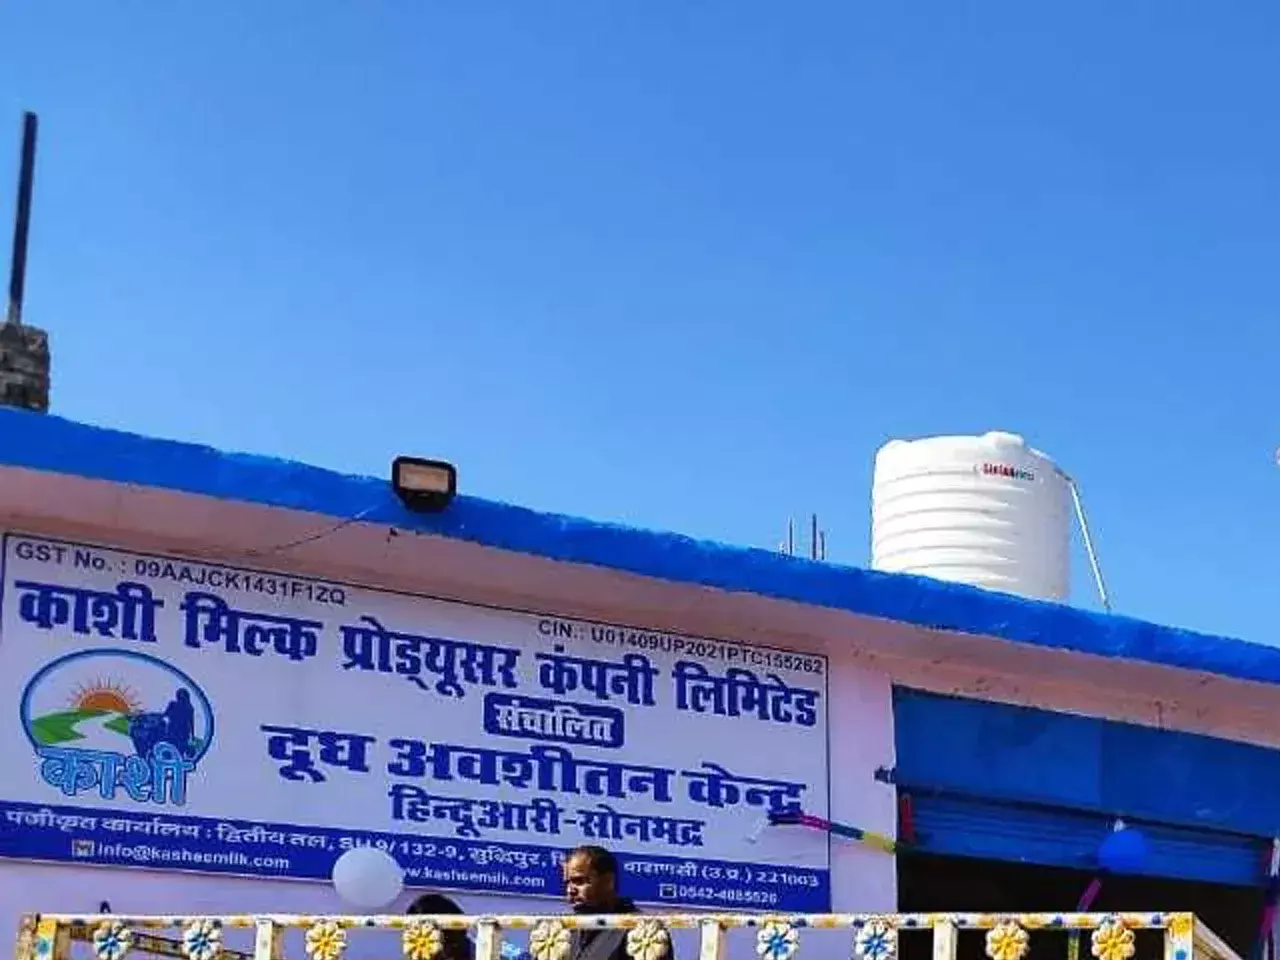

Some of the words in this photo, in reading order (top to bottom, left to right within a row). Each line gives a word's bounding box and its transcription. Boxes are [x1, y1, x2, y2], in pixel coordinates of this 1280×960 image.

[15, 541, 67, 564] GST
[75, 551, 113, 572] No.
[135, 559, 346, 606] 09AAJCK1431F1ZQ
[14, 580, 164, 643] काशी
[179, 591, 323, 661] मिल्क
[339, 615, 521, 699] प्रोड्यूसर
[535, 644, 660, 707] कंपनी
[672, 660, 820, 728] लिमिटेड
[493, 700, 615, 742] संचालित
[36, 741, 196, 807] काशी
[260, 725, 377, 783] दूध
[387, 739, 676, 803] अवशीतन
